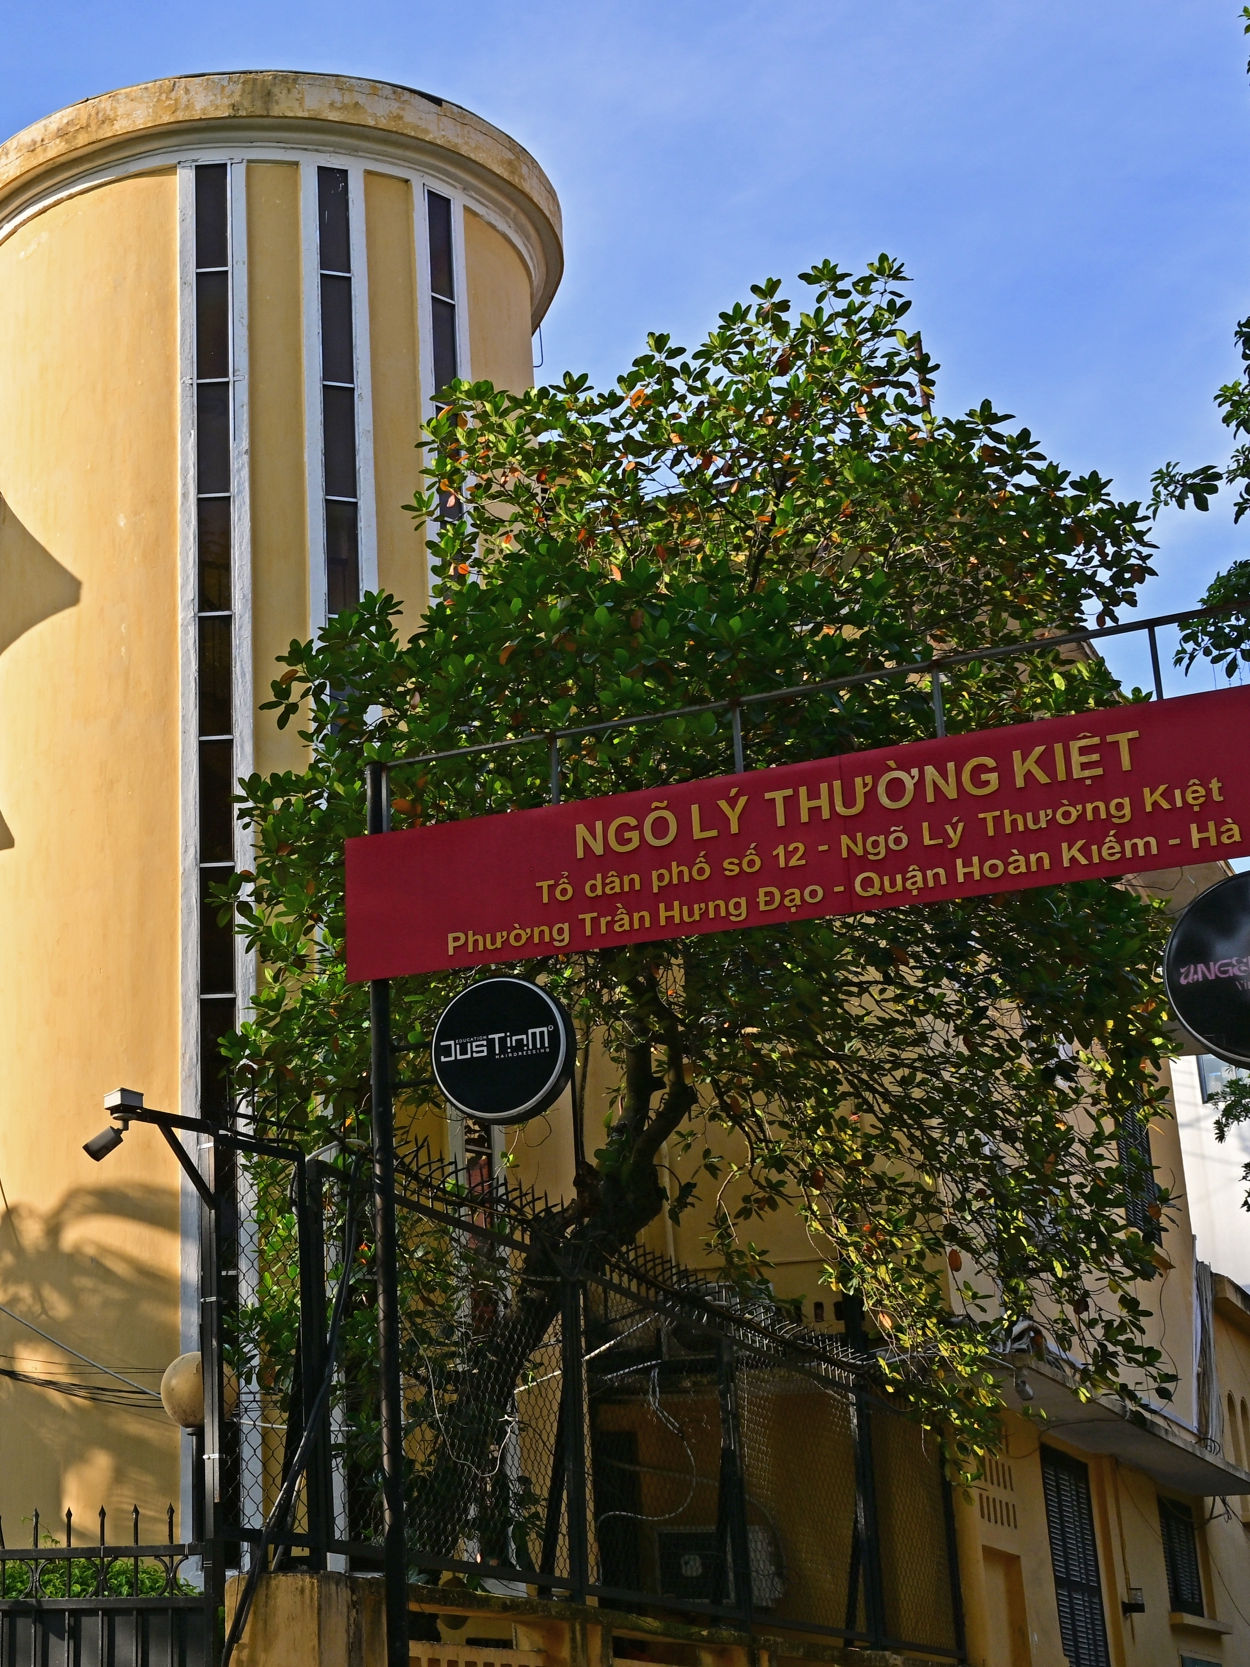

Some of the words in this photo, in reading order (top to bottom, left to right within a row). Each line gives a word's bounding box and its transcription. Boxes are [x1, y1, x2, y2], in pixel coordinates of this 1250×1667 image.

[575, 800, 679, 859] NGÕ
[691, 788, 748, 840] LÝ
[764, 756, 1000, 827] THƯỜNG
[1012, 730, 1140, 789] KIỆT
[447, 922, 570, 956] Phường
[578, 903, 651, 937] Trần
[658, 896, 747, 926] Hưng
[756, 884, 824, 913] Đạo
[854, 865, 947, 898] Quận
[955, 849, 1050, 883] Hoàn
[1189, 817, 1242, 849] Hà
[535, 871, 574, 904] Tổ
[584, 872, 642, 898] dân
[652, 851, 711, 893] phố
[723, 843, 762, 878] số
[772, 842, 806, 869] 12
[840, 825, 909, 860] Ngõ
[921, 816, 965, 849] Lý
[978, 796, 1132, 838] Thường
[456, 1035, 487, 1044] EDUCATION
[495, 1048, 550, 1059] HAIRDRESSING
